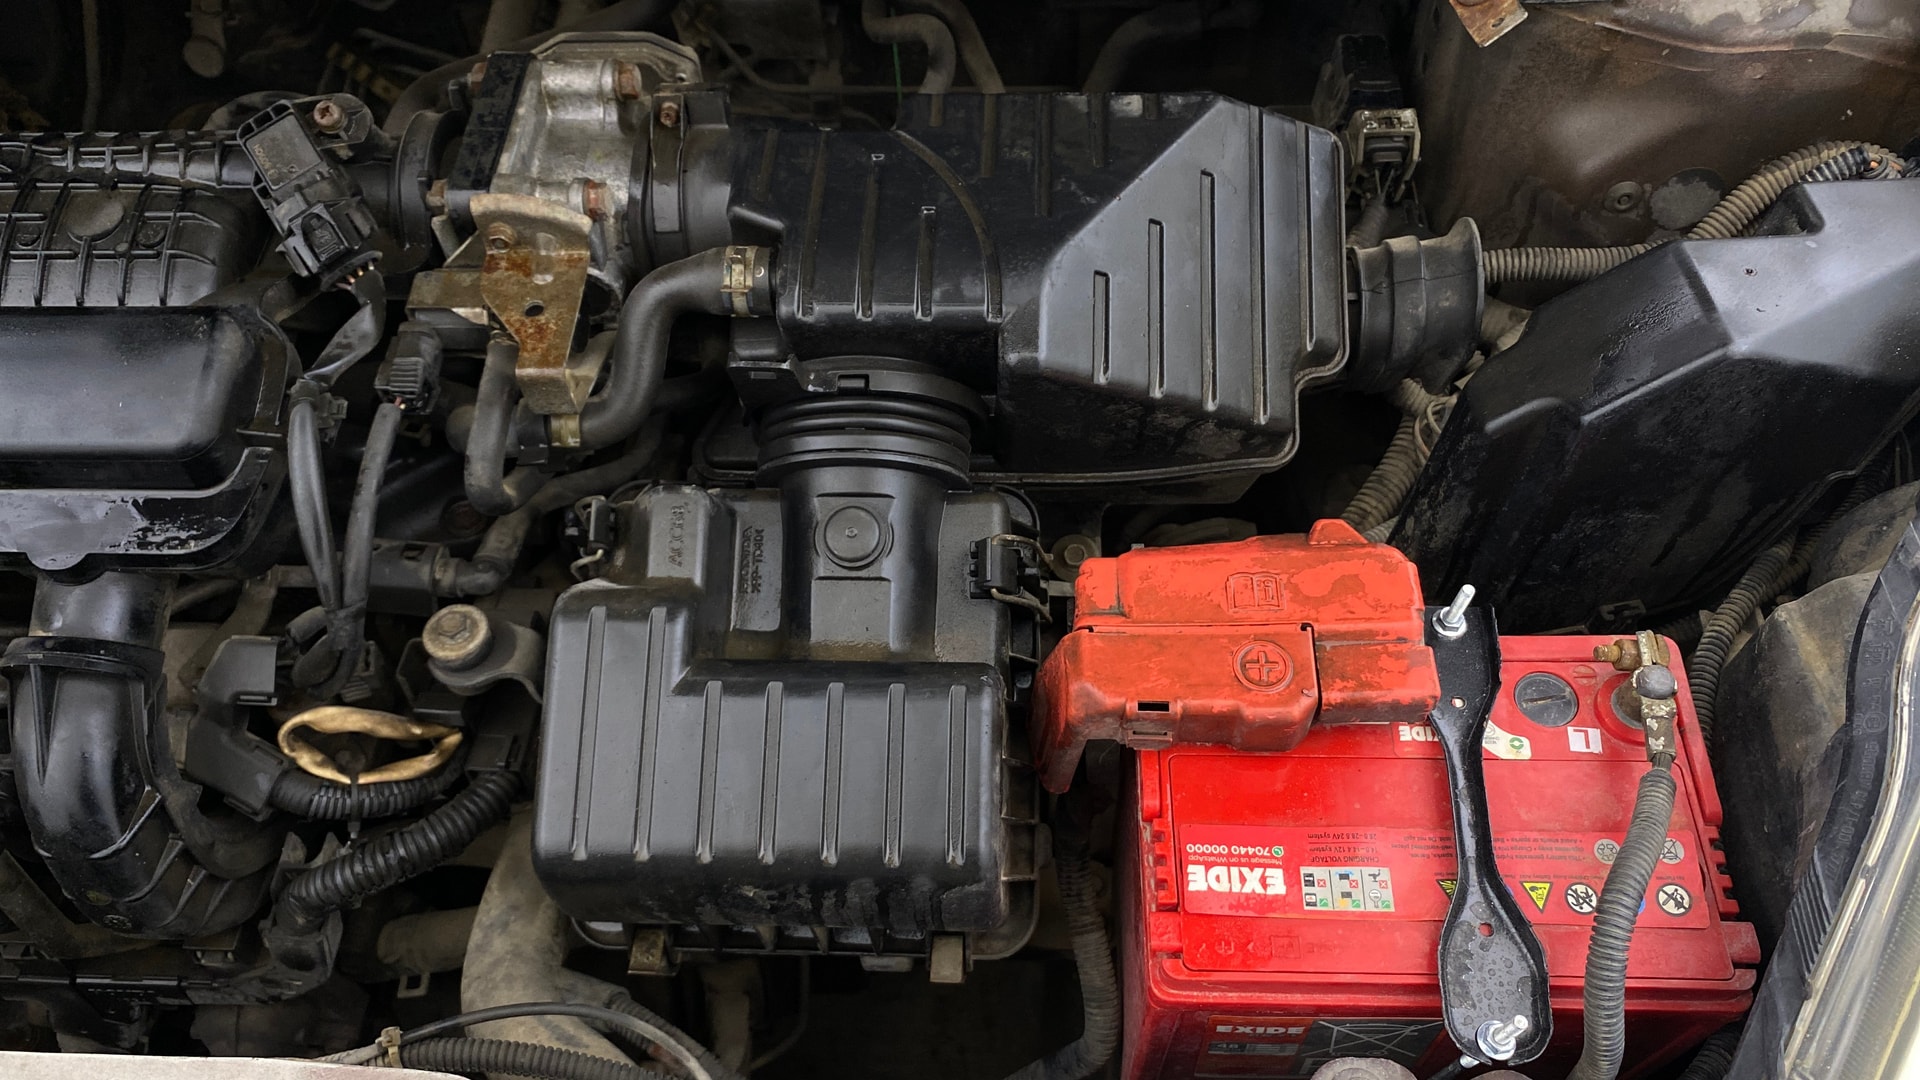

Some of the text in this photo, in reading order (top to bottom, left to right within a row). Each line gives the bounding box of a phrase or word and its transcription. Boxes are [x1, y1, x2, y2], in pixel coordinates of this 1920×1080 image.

[1307, 832, 1331, 840] system
[1186, 843, 1270, 856] 70440 00000
[1309, 845, 1332, 853] system
[1188, 854, 1227, 863] WhatsApp
[1251, 857, 1282, 865] Message
[1187, 864, 1286, 895] EXIDE
[1216, 1025, 1306, 1034] EXIDE
